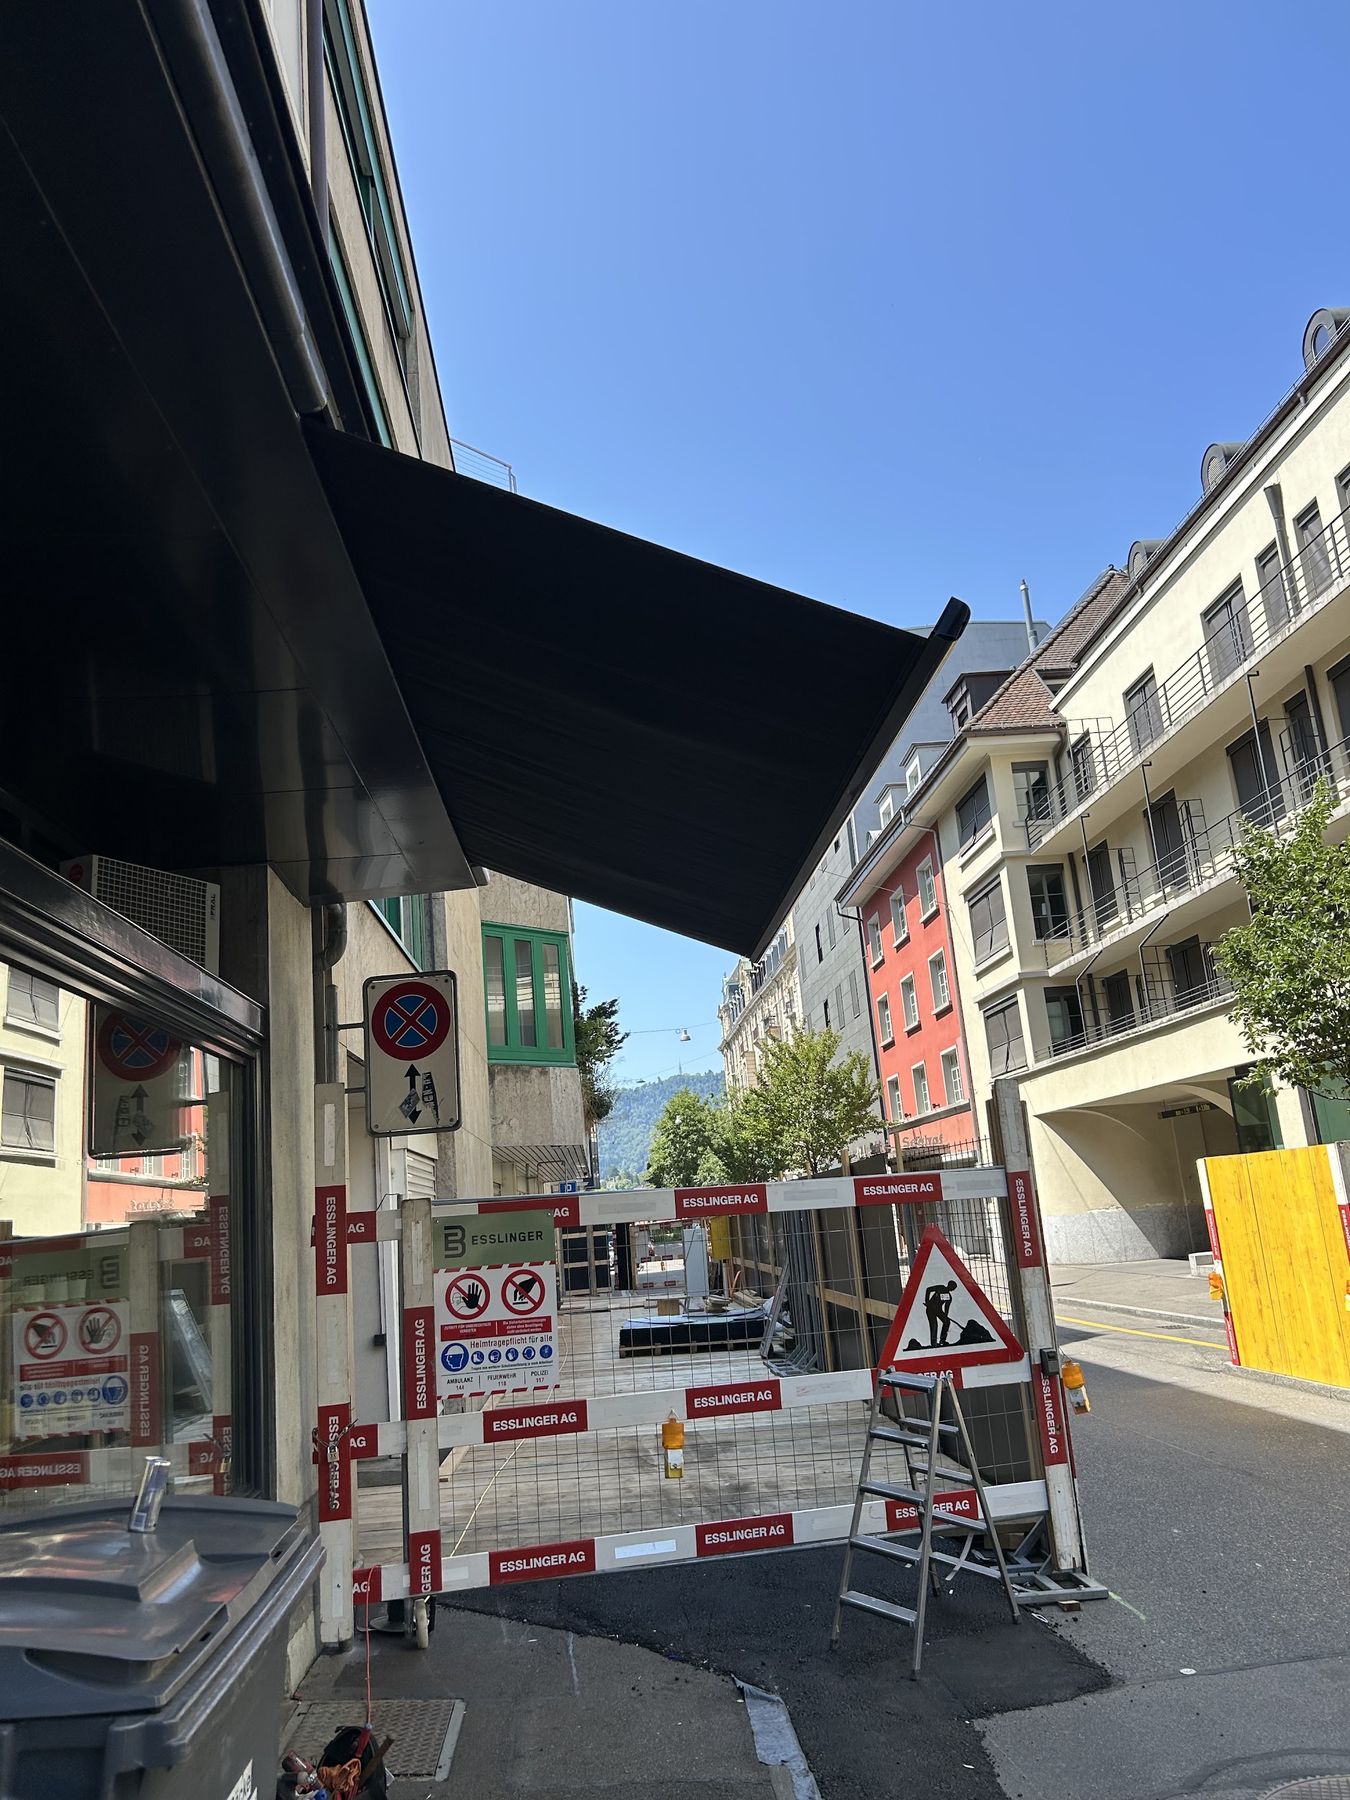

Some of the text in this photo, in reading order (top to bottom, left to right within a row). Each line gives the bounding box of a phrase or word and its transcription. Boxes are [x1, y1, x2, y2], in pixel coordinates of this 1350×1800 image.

[863, 1183, 934, 1196] ESSLINGER AG
[683, 1193, 759, 1208] ESSLINGER AG
[553, 1207, 570, 1218] AG
[1015, 1178, 1033, 1257] ESSLINGER AG
[347, 1222, 365, 1234] AG
[326, 1196, 337, 1285] ESSLINGER AG
[471, 1230, 544, 1246] ESSLINGER
[470, 1337, 527, 1349] Helmtragepflicht
[540, 1334, 553, 1342] alle
[415, 1319, 427, 1409] ESSLINGER AG
[447, 1376, 474, 1385] AMBULANZ
[487, 1373, 517, 1381] FEUERWEHR
[939, 1369, 954, 1381] AG
[694, 1390, 773, 1408] ESSLINGER AG
[493, 1412, 577, 1432] ESSLINGER AG
[350, 1436, 366, 1448] AG
[1049, 1436, 1059, 1454] AG
[328, 1416, 340, 1489] ESSGER
[896, 1500, 970, 1519] ESSGER AG
[705, 1524, 785, 1545] ESSLINGER AG
[420, 1543, 431, 1564] AG
[500, 1551, 586, 1573] ESSLINGER AG
[352, 1581, 370, 1594] AG
